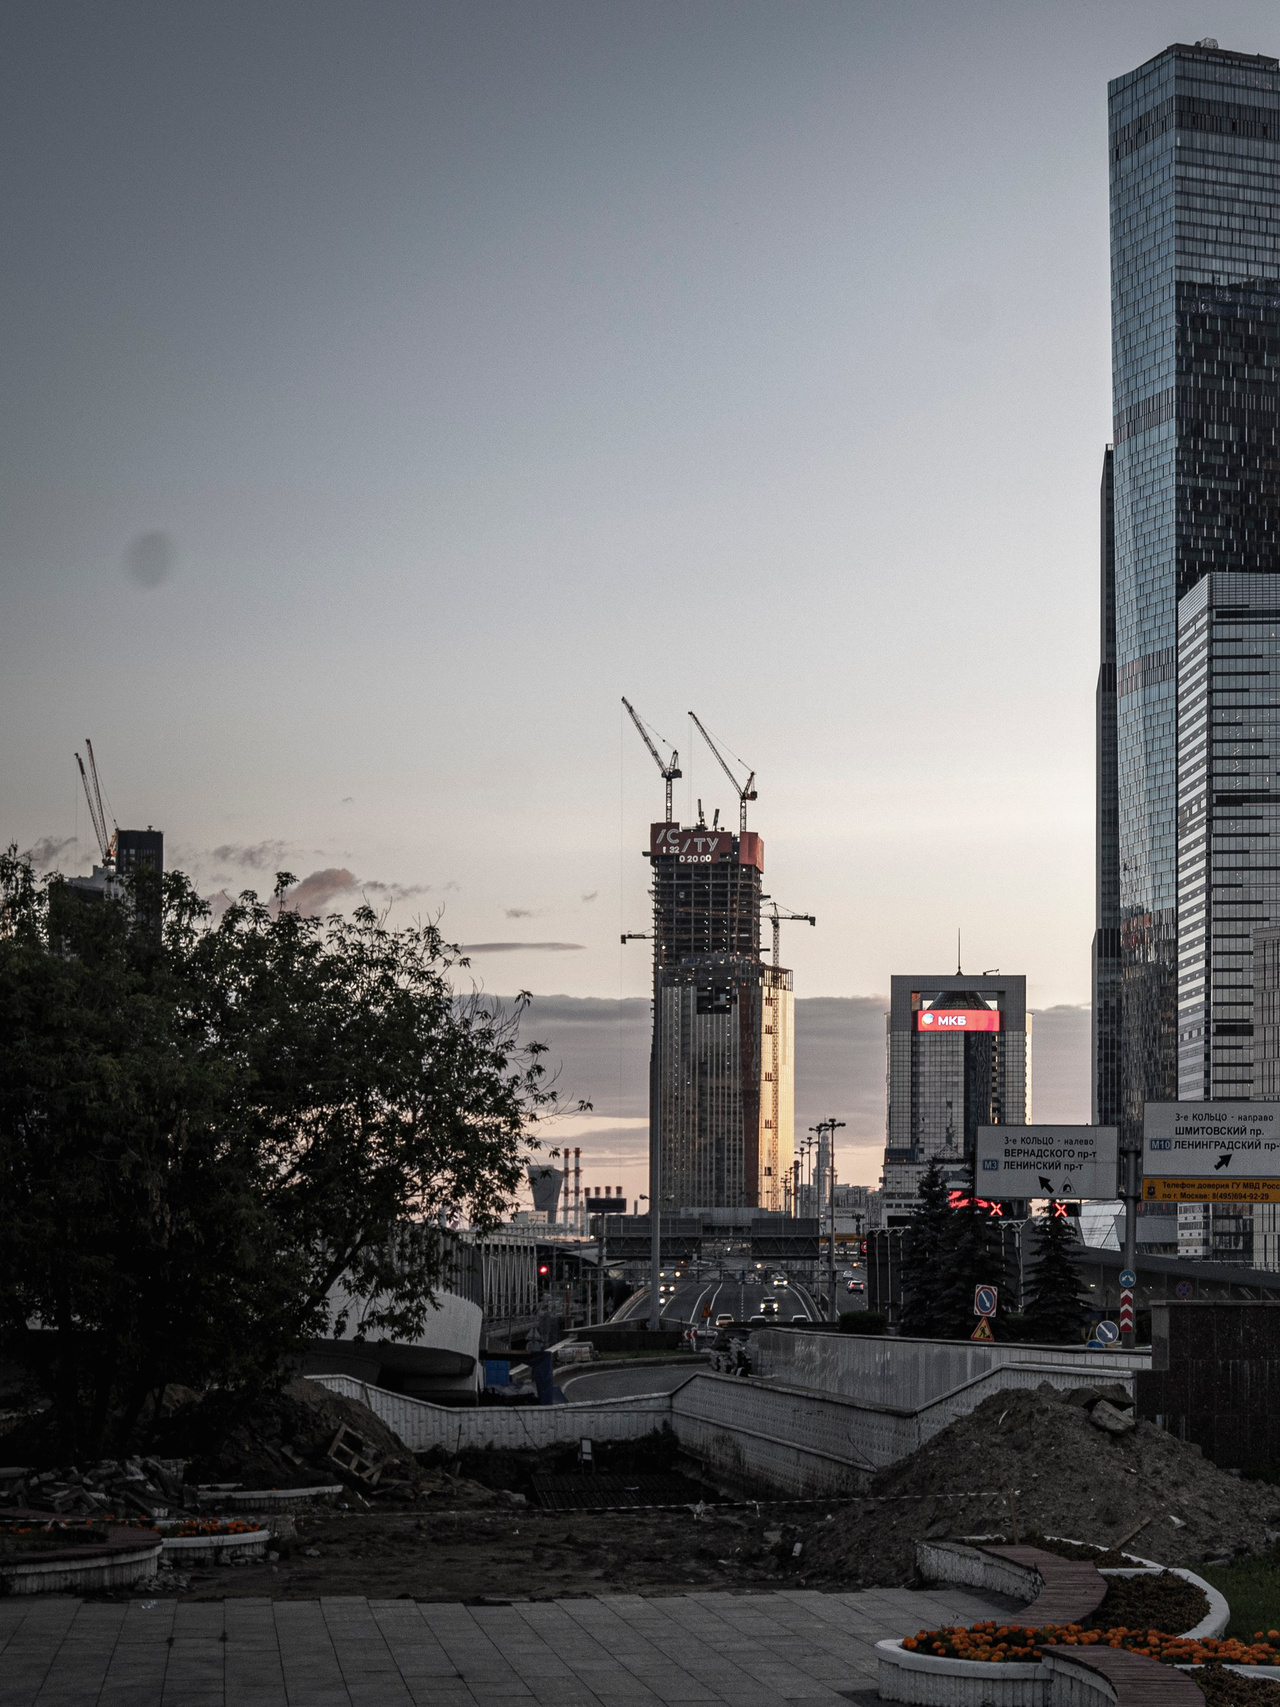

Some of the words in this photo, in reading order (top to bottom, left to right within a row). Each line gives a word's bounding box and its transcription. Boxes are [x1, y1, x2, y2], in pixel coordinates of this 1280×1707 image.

[938, 1016, 967, 1026] МКБ
[1175, 1113, 1188, 1122] 3-е
[1192, 1113, 1228, 1123] КОЛЬЦО
[1238, 1114, 1274, 1123] направо
[1175, 1126, 1247, 1136] ШМИТОВСКИЙ
[1004, 1137, 1017, 1145] 3-е
[1020, 1137, 1054, 1146] КОЛЬЦО
[1151, 1140, 1171, 1149] М10
[1174, 1141, 1261, 1151] ЛЕНИНГРАДСКИЙ
[1004, 1149, 1075, 1159] ВЕРНАДСКОГО
[1077, 1151, 1097, 1160] пр-т
[984, 1160, 997, 1170] М3
[1003, 1161, 1061, 1171] ЛЕНИНСКИЙ
[1064, 1163, 1083, 1172] пр-т
[1163, 1181, 1195, 1190] Телефон
[1197, 1183, 1229, 1191] доверия
[1231, 1182, 1240, 1190] ГУ
[1243, 1183, 1260, 1191] МВД
[1180, 1192, 1210, 1200] Москве:
